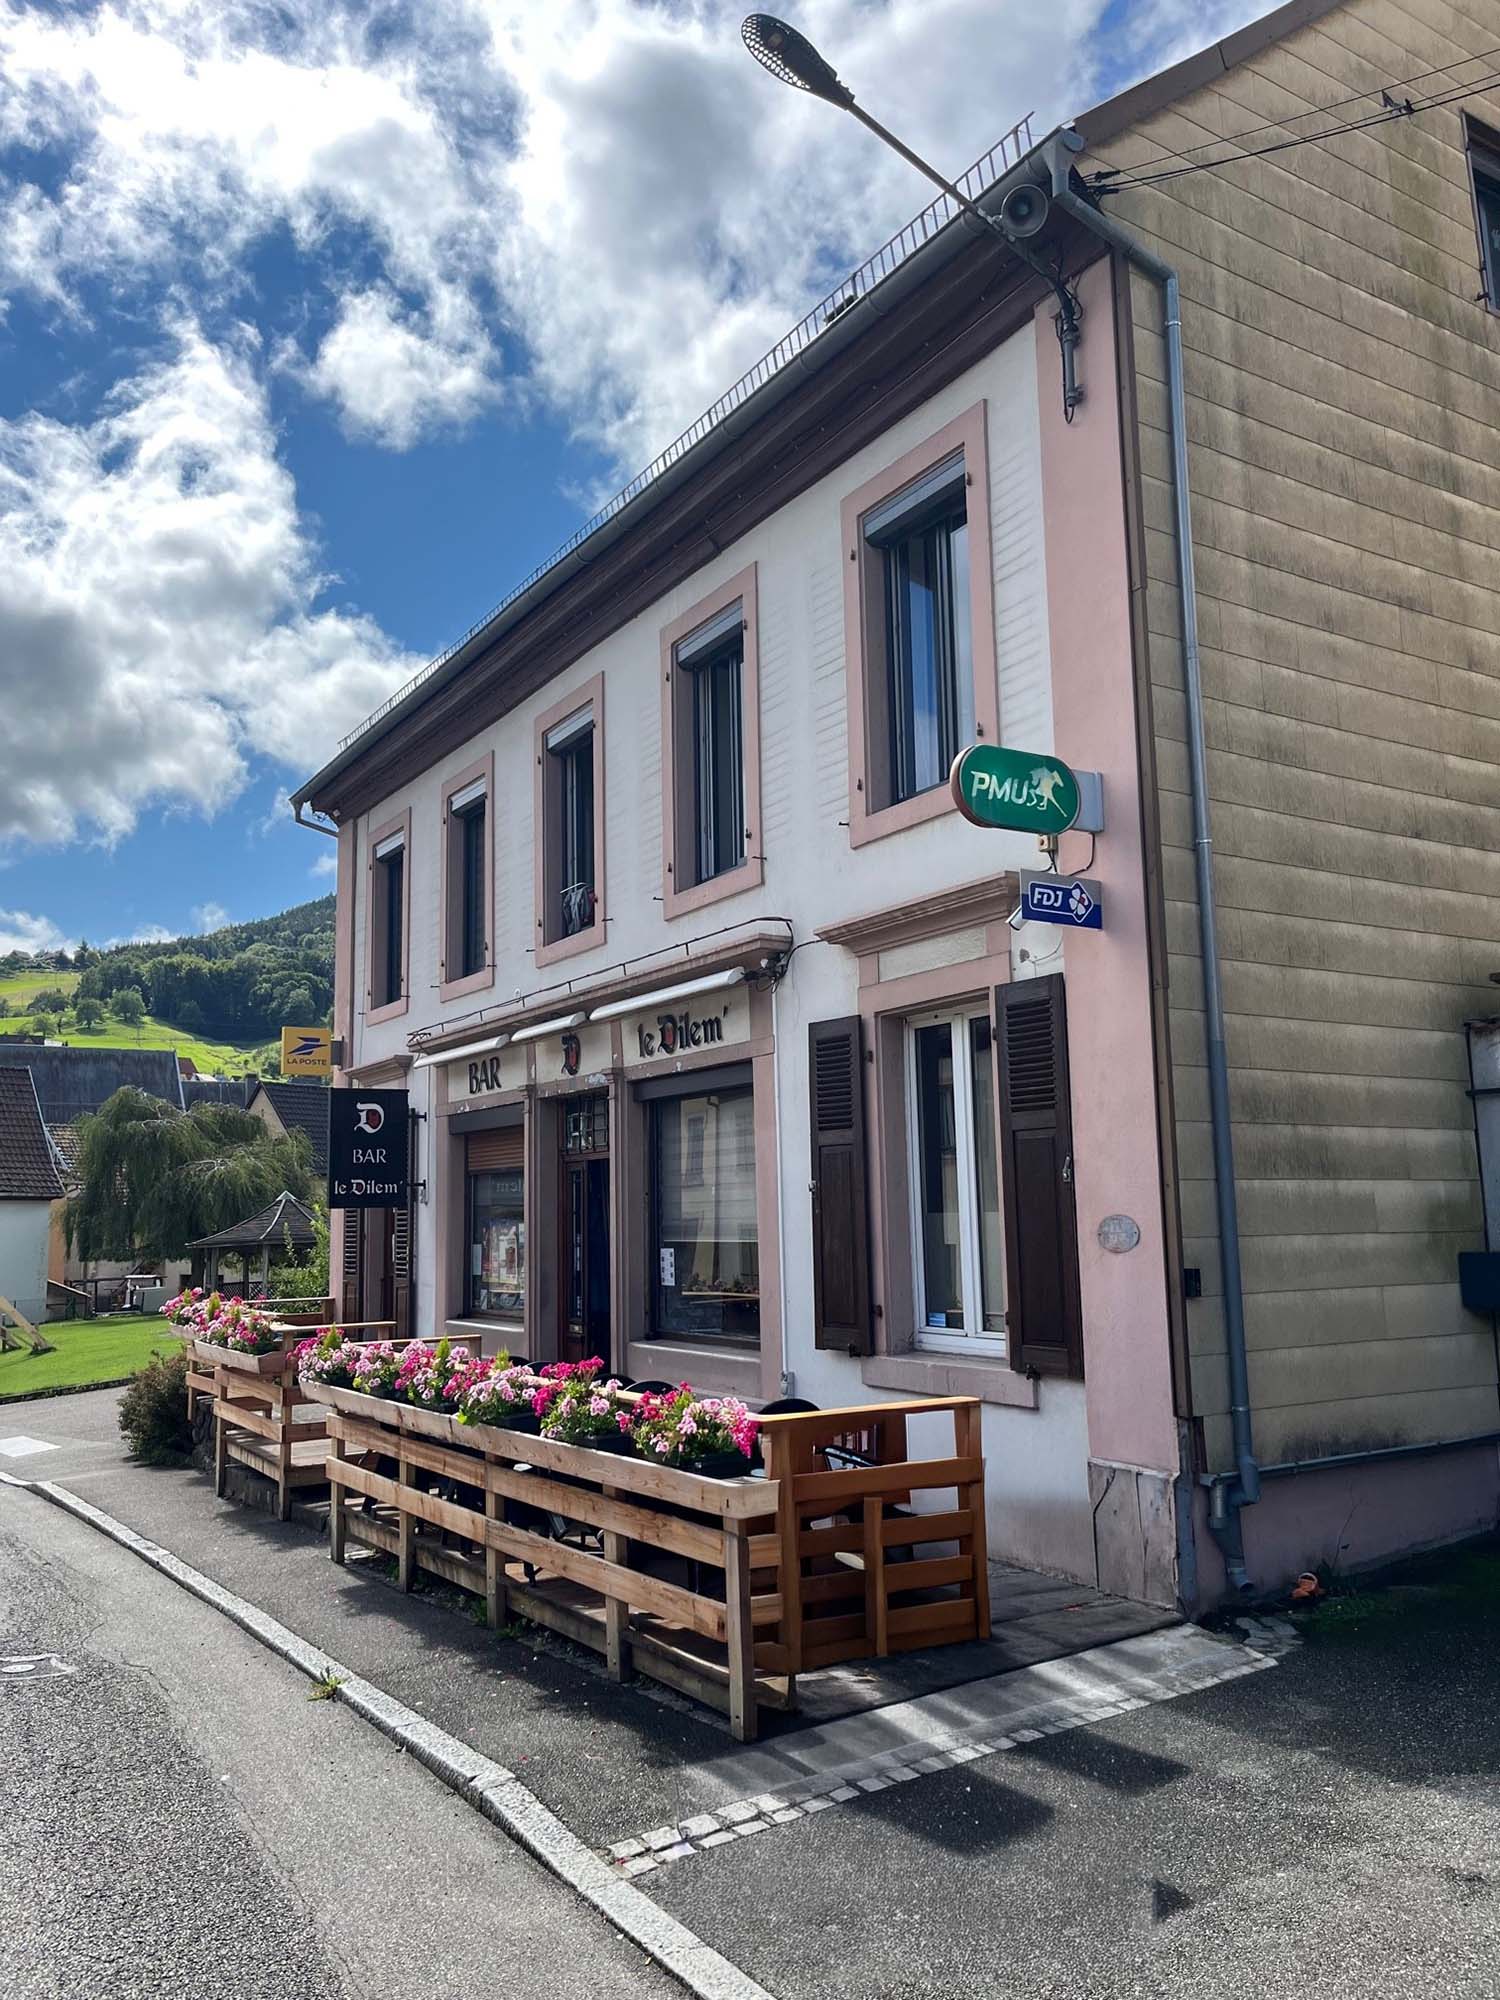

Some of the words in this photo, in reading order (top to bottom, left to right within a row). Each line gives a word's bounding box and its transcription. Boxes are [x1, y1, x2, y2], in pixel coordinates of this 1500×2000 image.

[970, 770, 1029, 805] PMU
[1033, 887, 1063, 908] FDJ
[637, 1023, 655, 1058] le
[657, 1005, 729, 1055] Dilem'
[299, 1058, 327, 1066] POSTE
[468, 1056, 502, 1094] BAR
[353, 1102, 385, 1134] D
[353, 1148, 387, 1164] BAR
[334, 1180, 347, 1195] le
[349, 1179, 403, 1196] Dilem'
